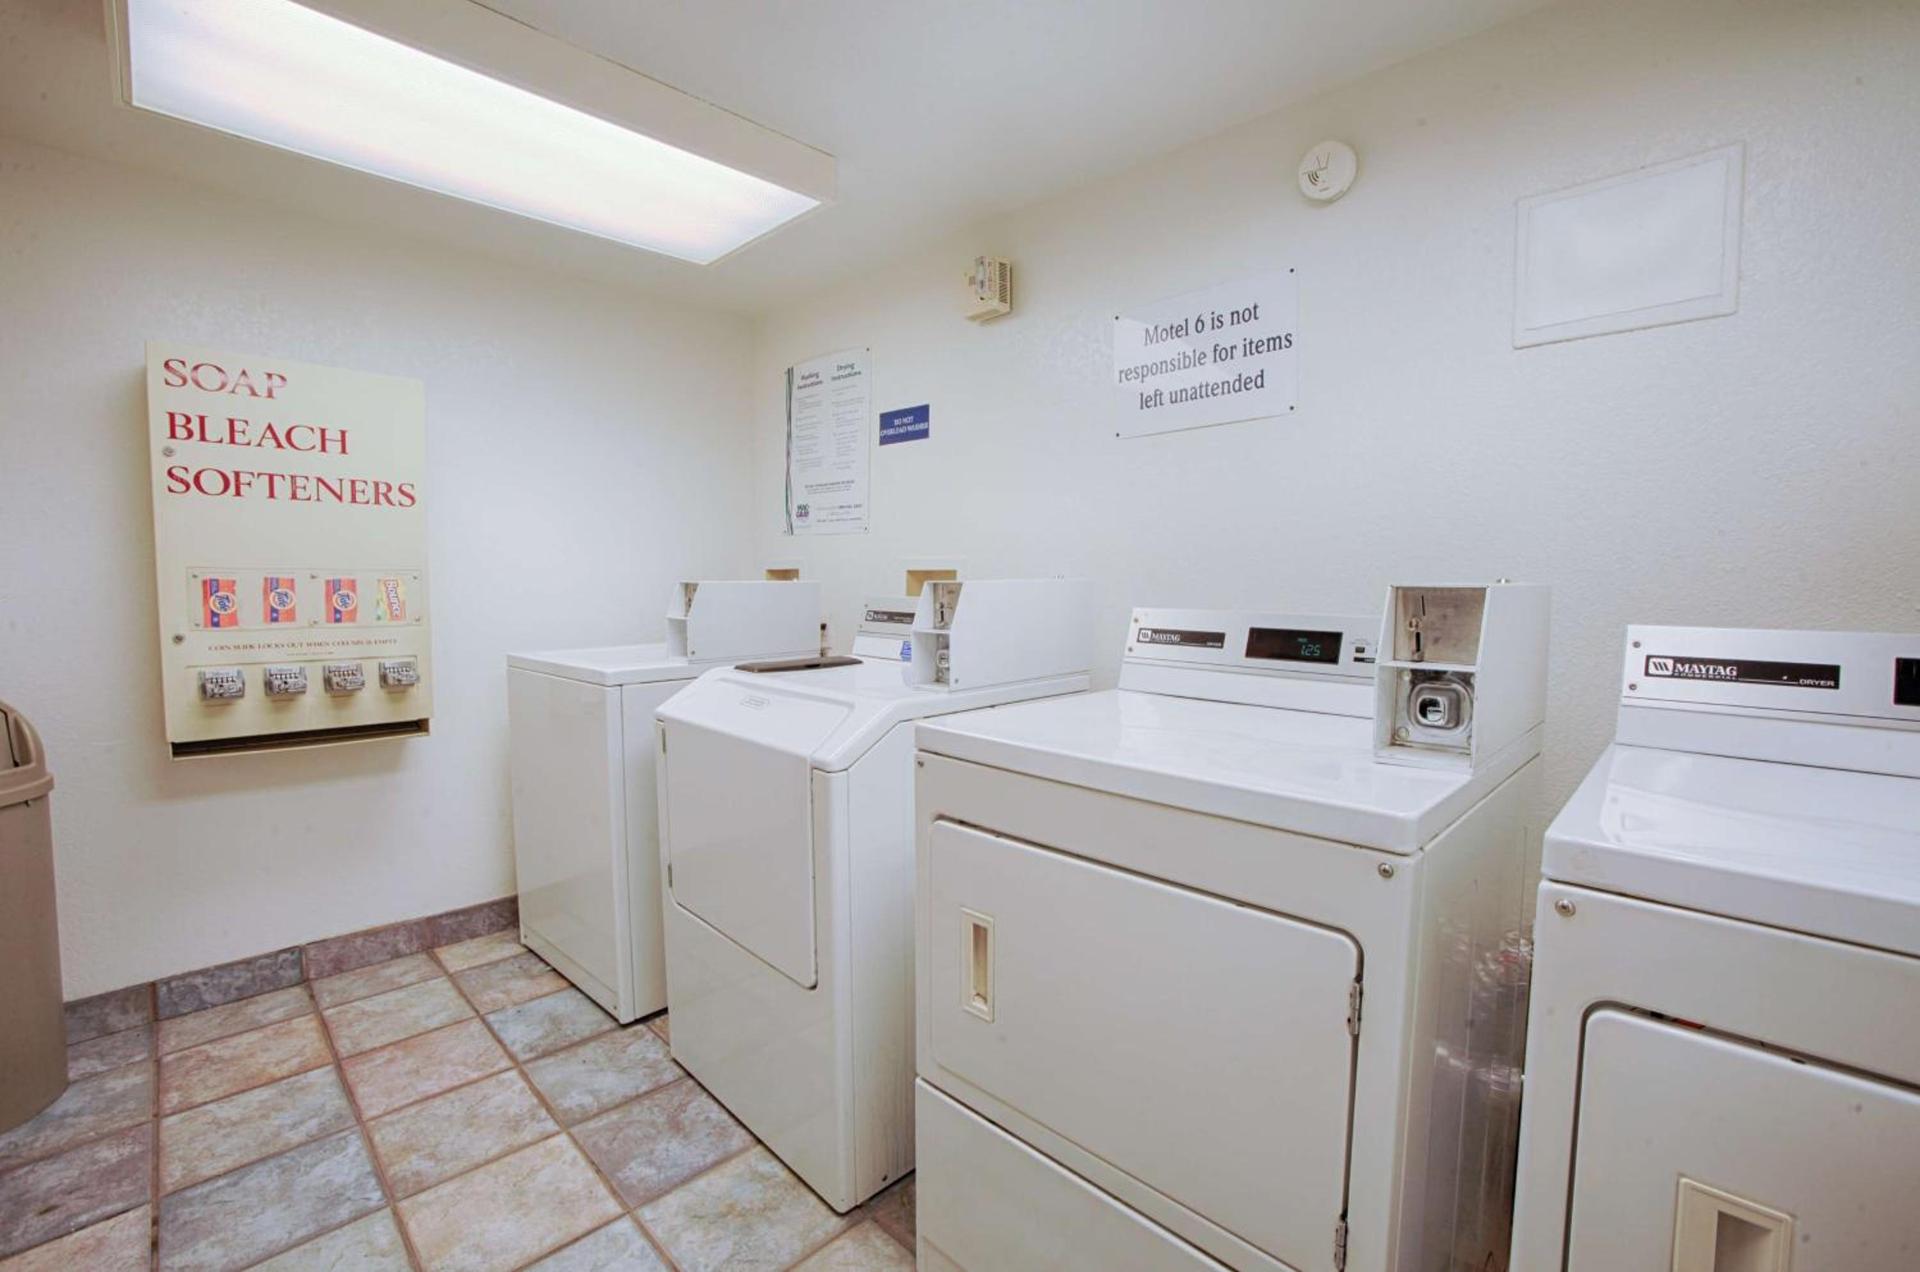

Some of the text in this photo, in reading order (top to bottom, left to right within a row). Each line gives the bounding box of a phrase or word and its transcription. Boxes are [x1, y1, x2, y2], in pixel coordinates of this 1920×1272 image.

[1144, 302, 1260, 346] Motel 6 is not
[163, 358, 288, 400] SOAP
[1118, 332, 1293, 384] responsible for items
[1139, 368, 1265, 410] left unattended
[166, 411, 349, 456] BLEACH
[166, 465, 416, 508] SOFTENERS
[1152, 632, 1181, 642] MAYTAG
[1674, 663, 1738, 677] MAYTAG
[1799, 678, 1835, 687] DRYER
